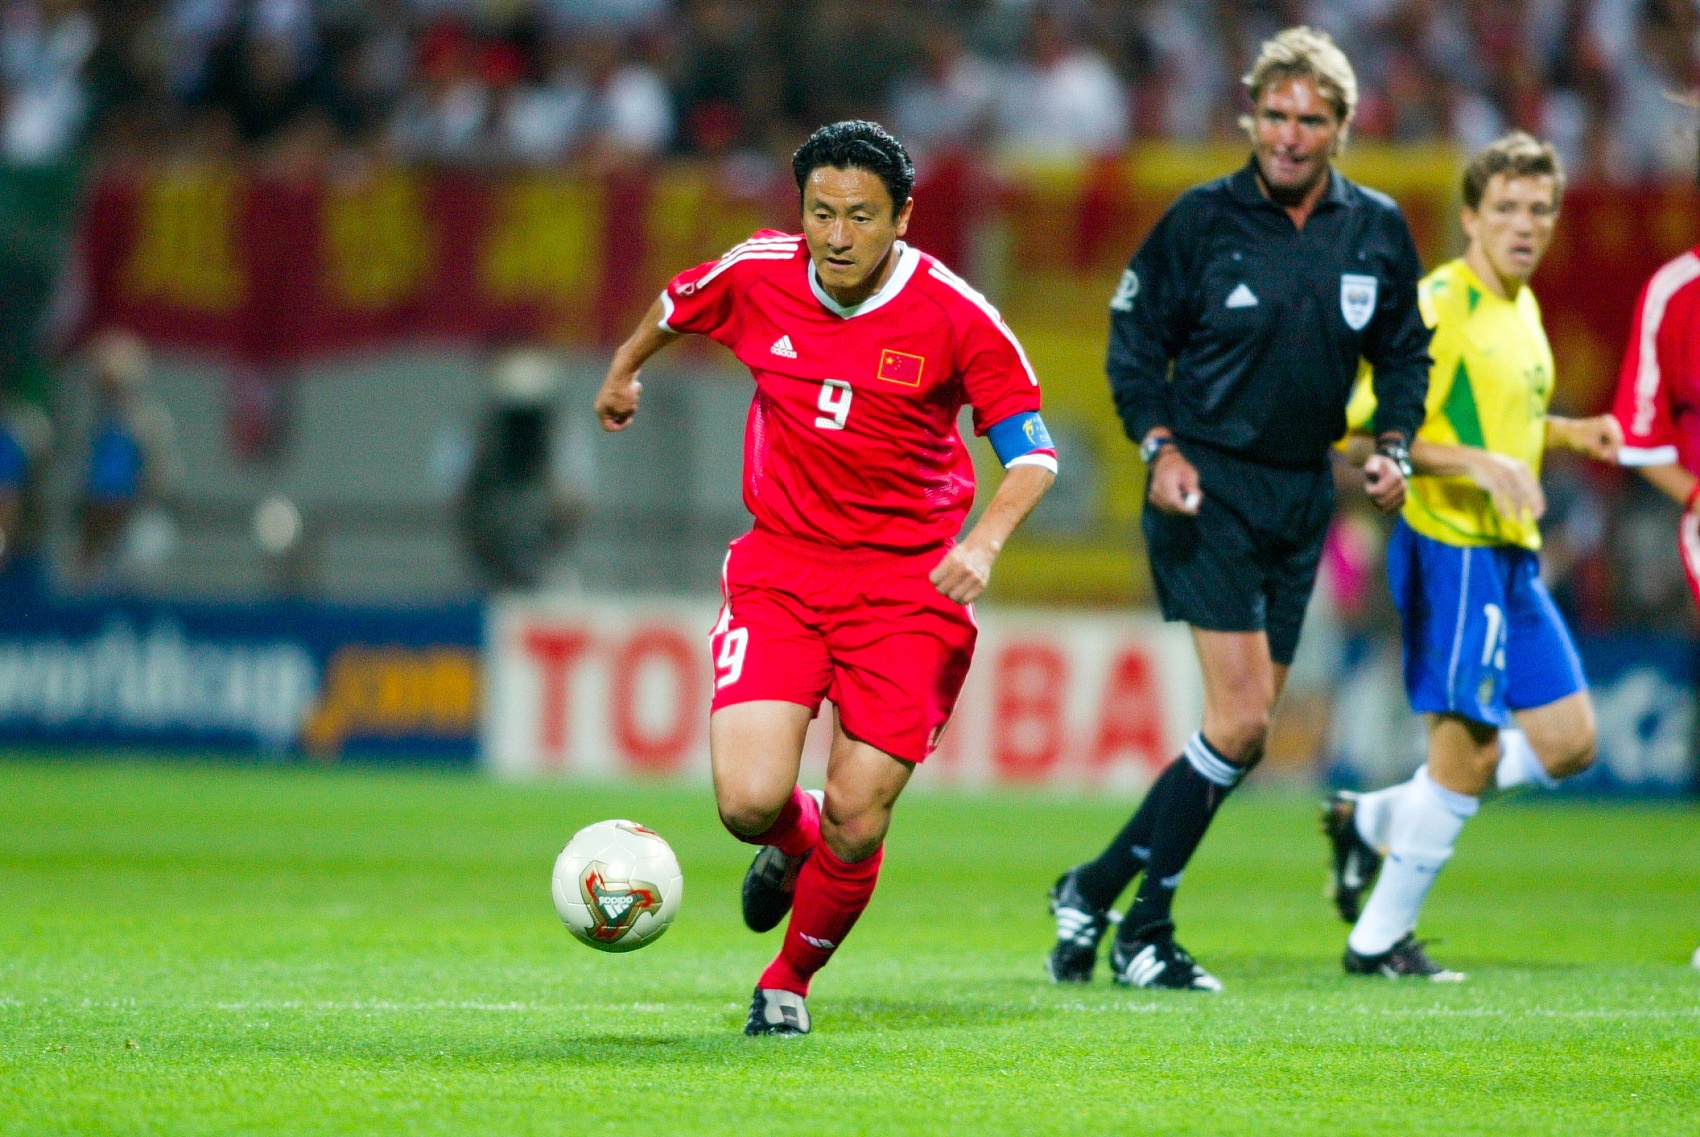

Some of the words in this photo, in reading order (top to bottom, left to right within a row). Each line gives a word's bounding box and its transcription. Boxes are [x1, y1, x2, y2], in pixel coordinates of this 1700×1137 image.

[770, 345, 798, 359] adidas
[814, 378, 853, 430] 9
[718, 627, 749, 689] 9
